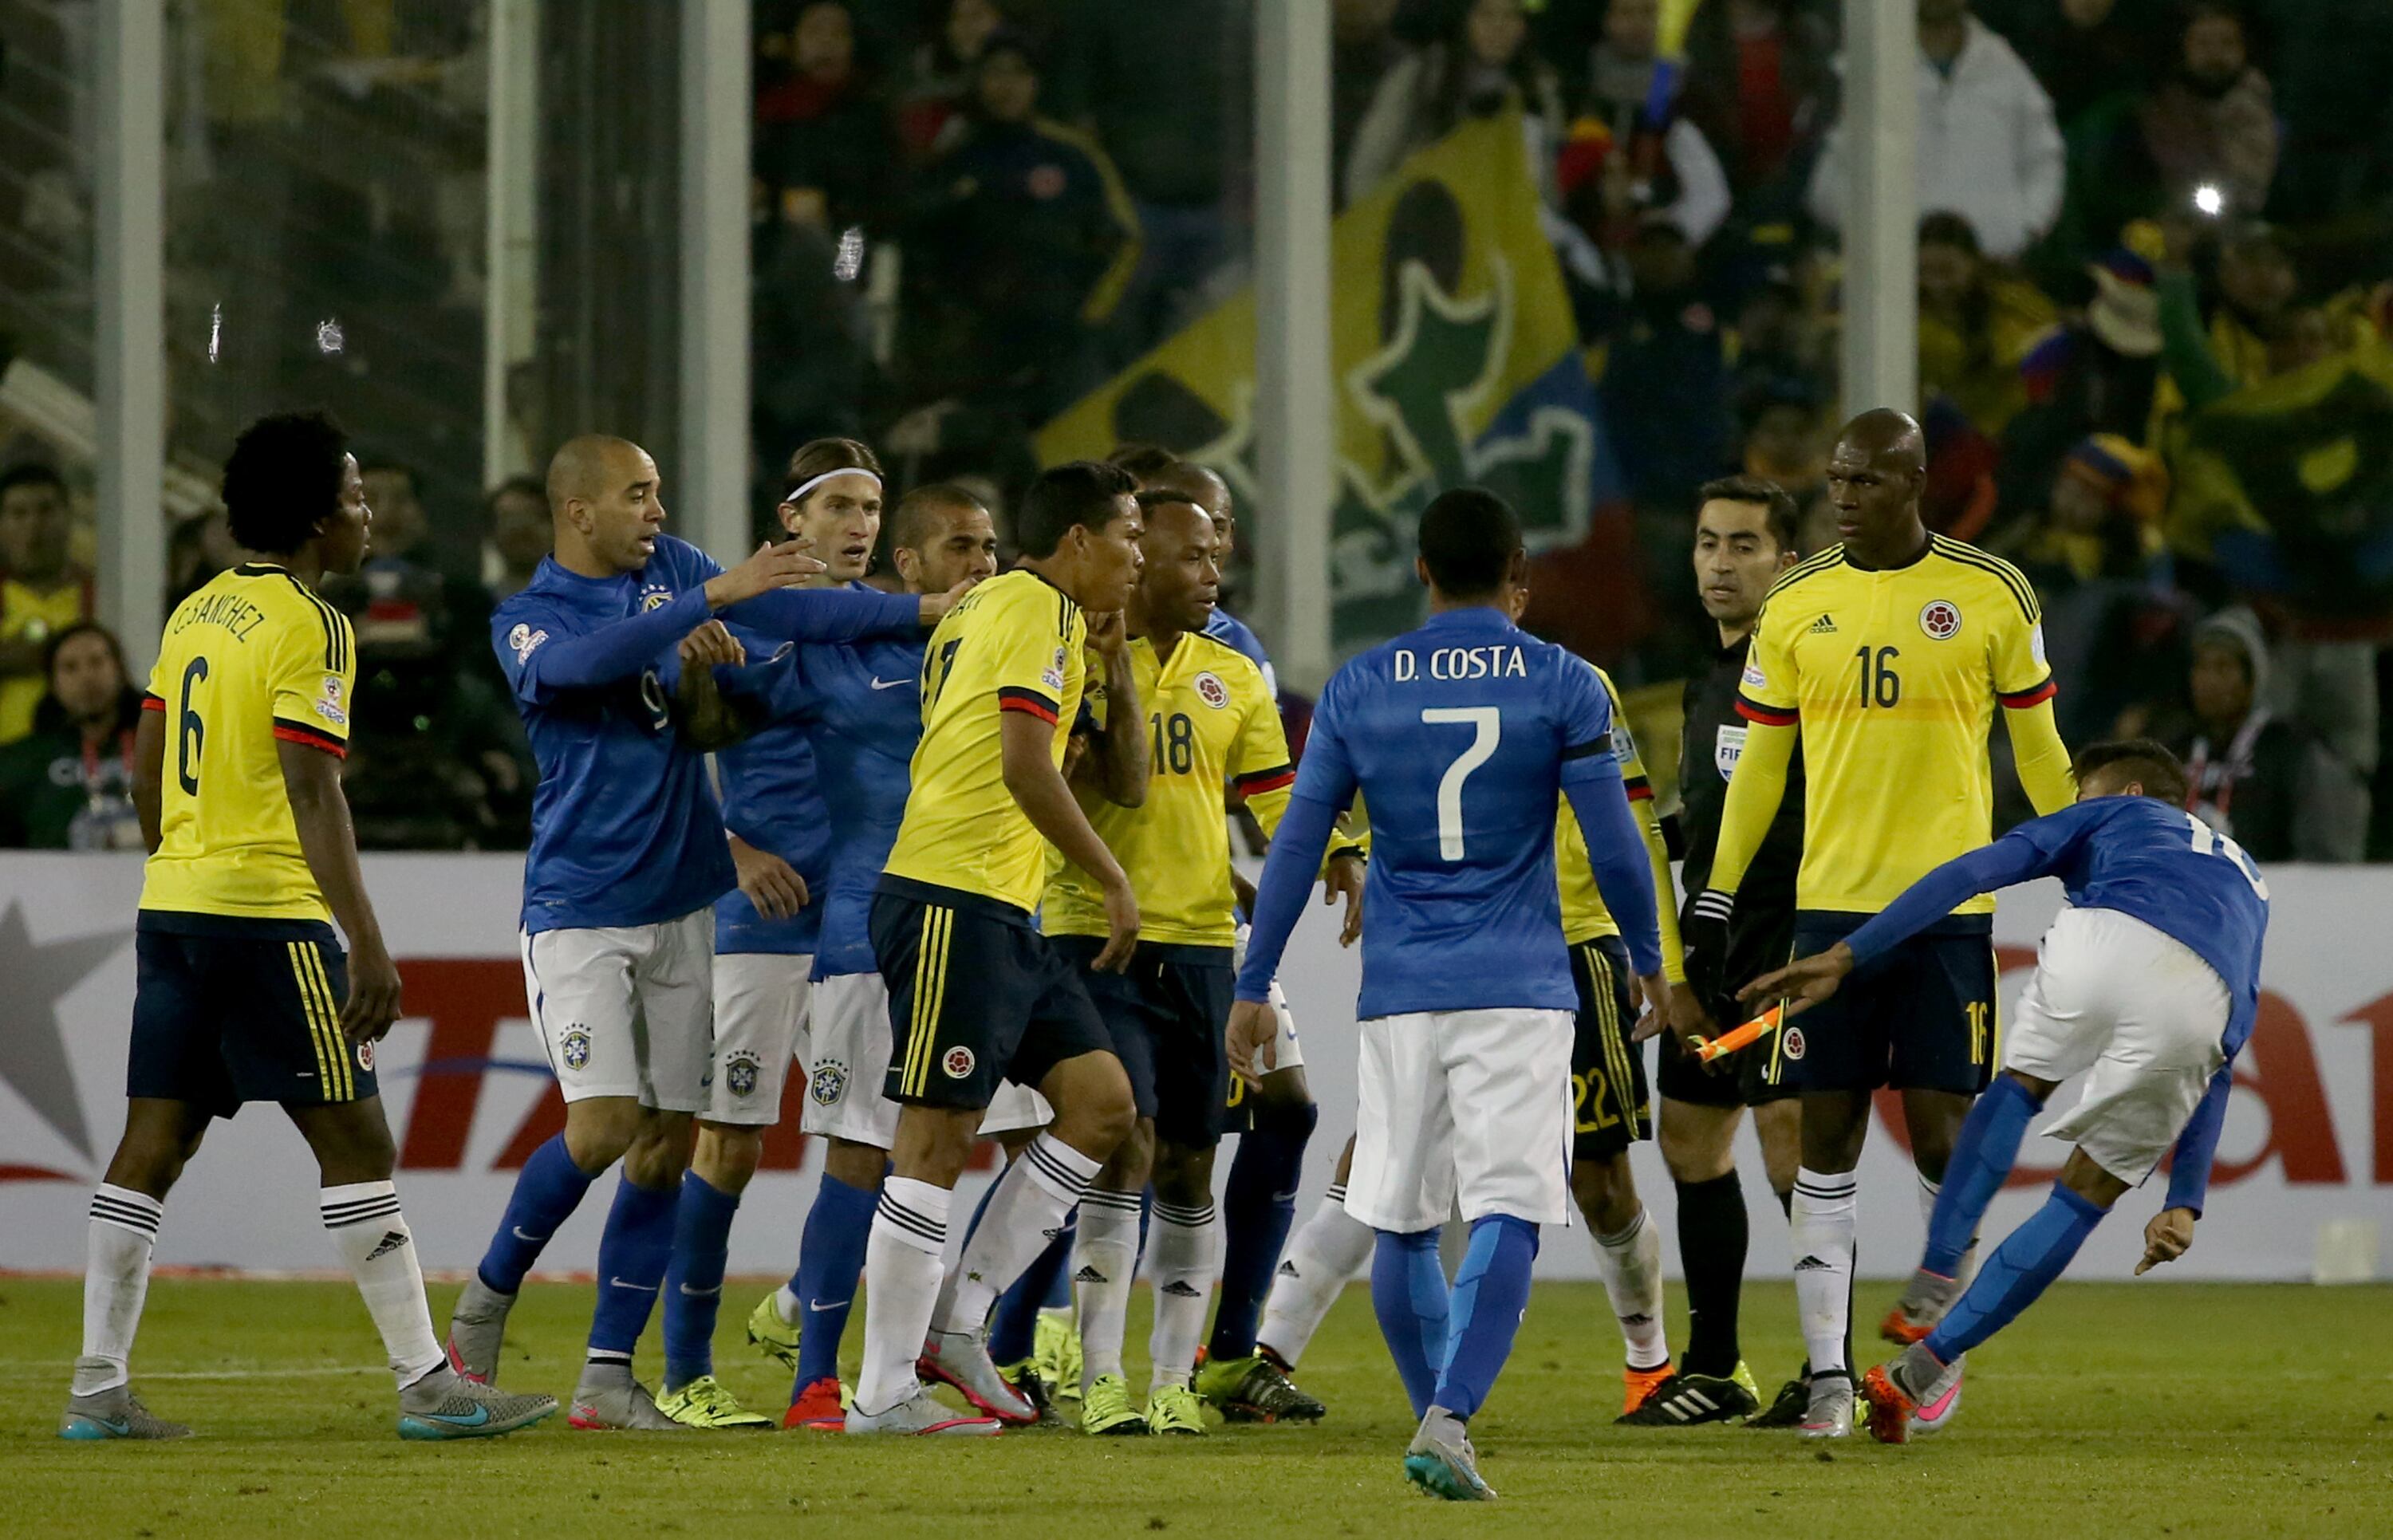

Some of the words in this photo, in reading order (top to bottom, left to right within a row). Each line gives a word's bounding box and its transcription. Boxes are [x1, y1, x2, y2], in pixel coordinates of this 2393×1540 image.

[1394, 648, 1420, 682] D.
[1429, 645, 1528, 679] COSTA
[1855, 645, 1901, 709] 16
[179, 656, 209, 798] 6
[640, 670, 669, 730] 9
[1149, 712, 1193, 775] 18
[1721, 746, 1743, 761] FIF
[1421, 706, 1500, 861] 7
[1965, 1001, 1988, 1065] 16
[1571, 1067, 1620, 1134] 22
